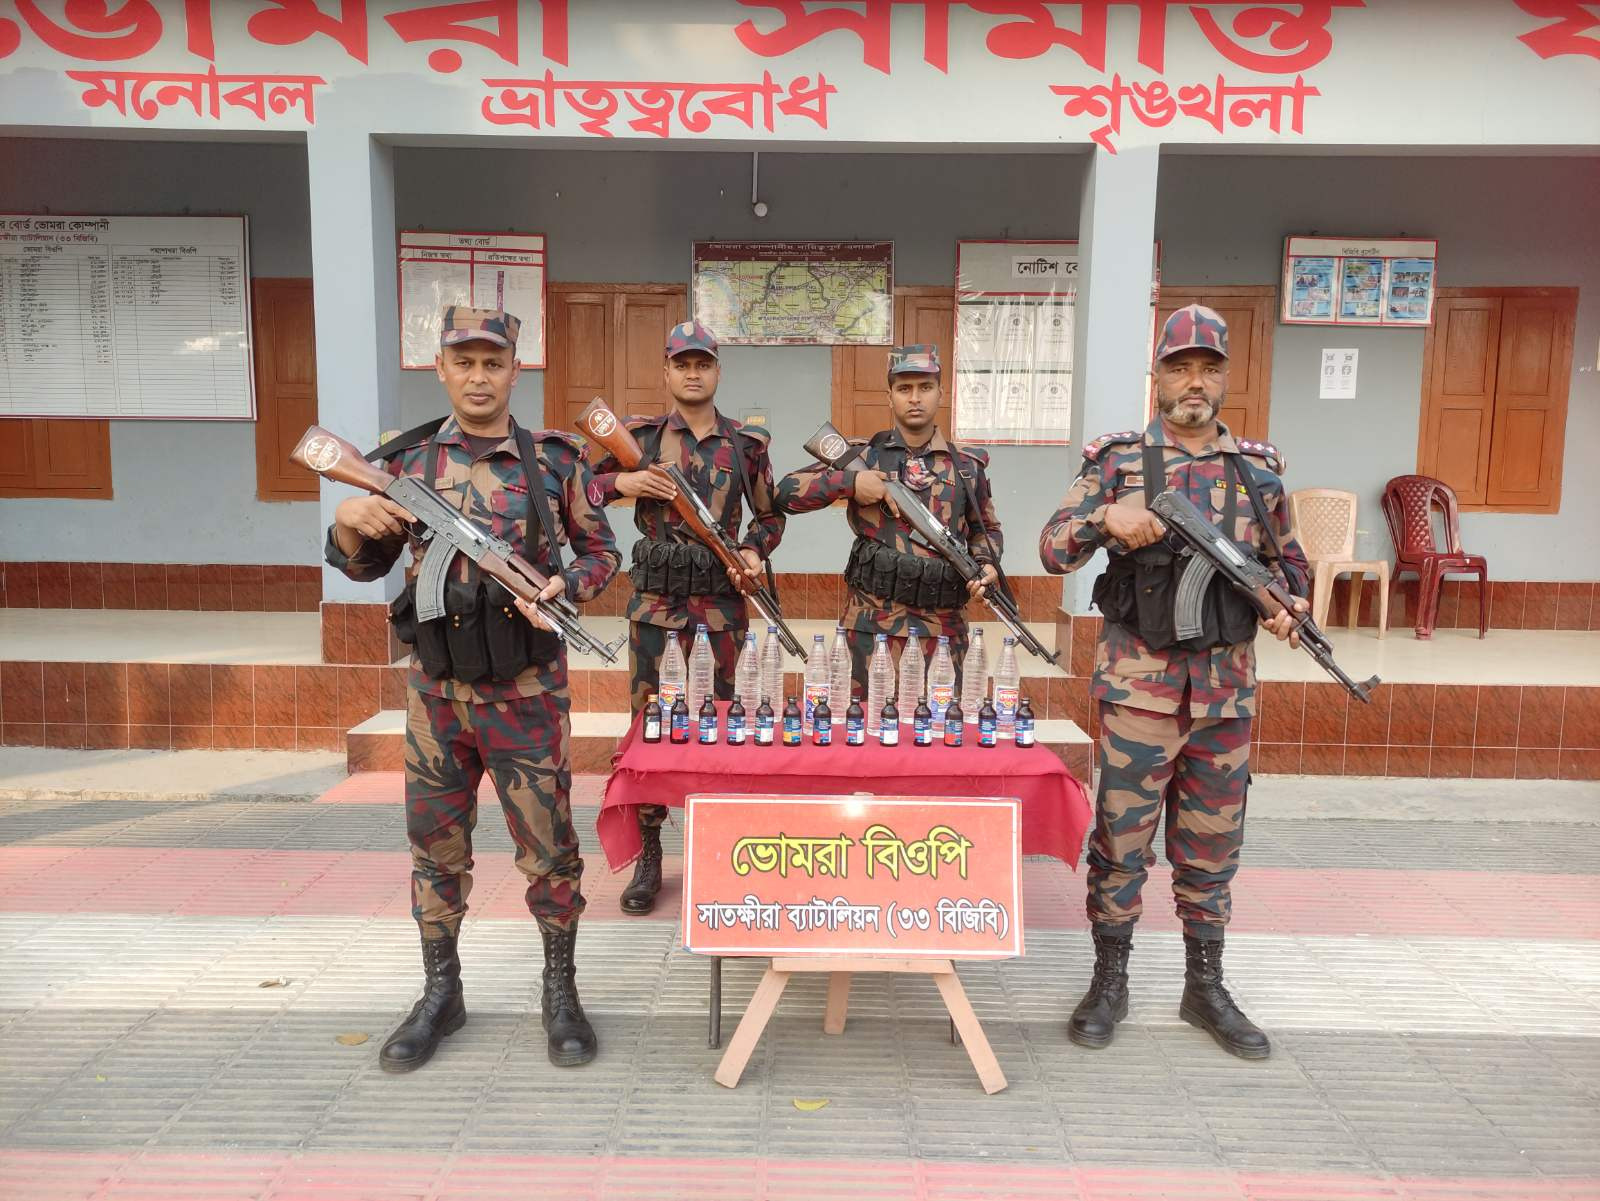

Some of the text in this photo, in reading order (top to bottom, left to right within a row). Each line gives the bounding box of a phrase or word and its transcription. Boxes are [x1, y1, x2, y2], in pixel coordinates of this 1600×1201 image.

[66, 64, 325, 124] মনোবল
[1016, 257, 1059, 275] নোটিশ
[731, 824, 974, 881] ভোমরা বিওপি
[696, 894, 1009, 940] সাতক্ষীরা ব্যাটালিয়ন (৩৩ বিজিবি)
